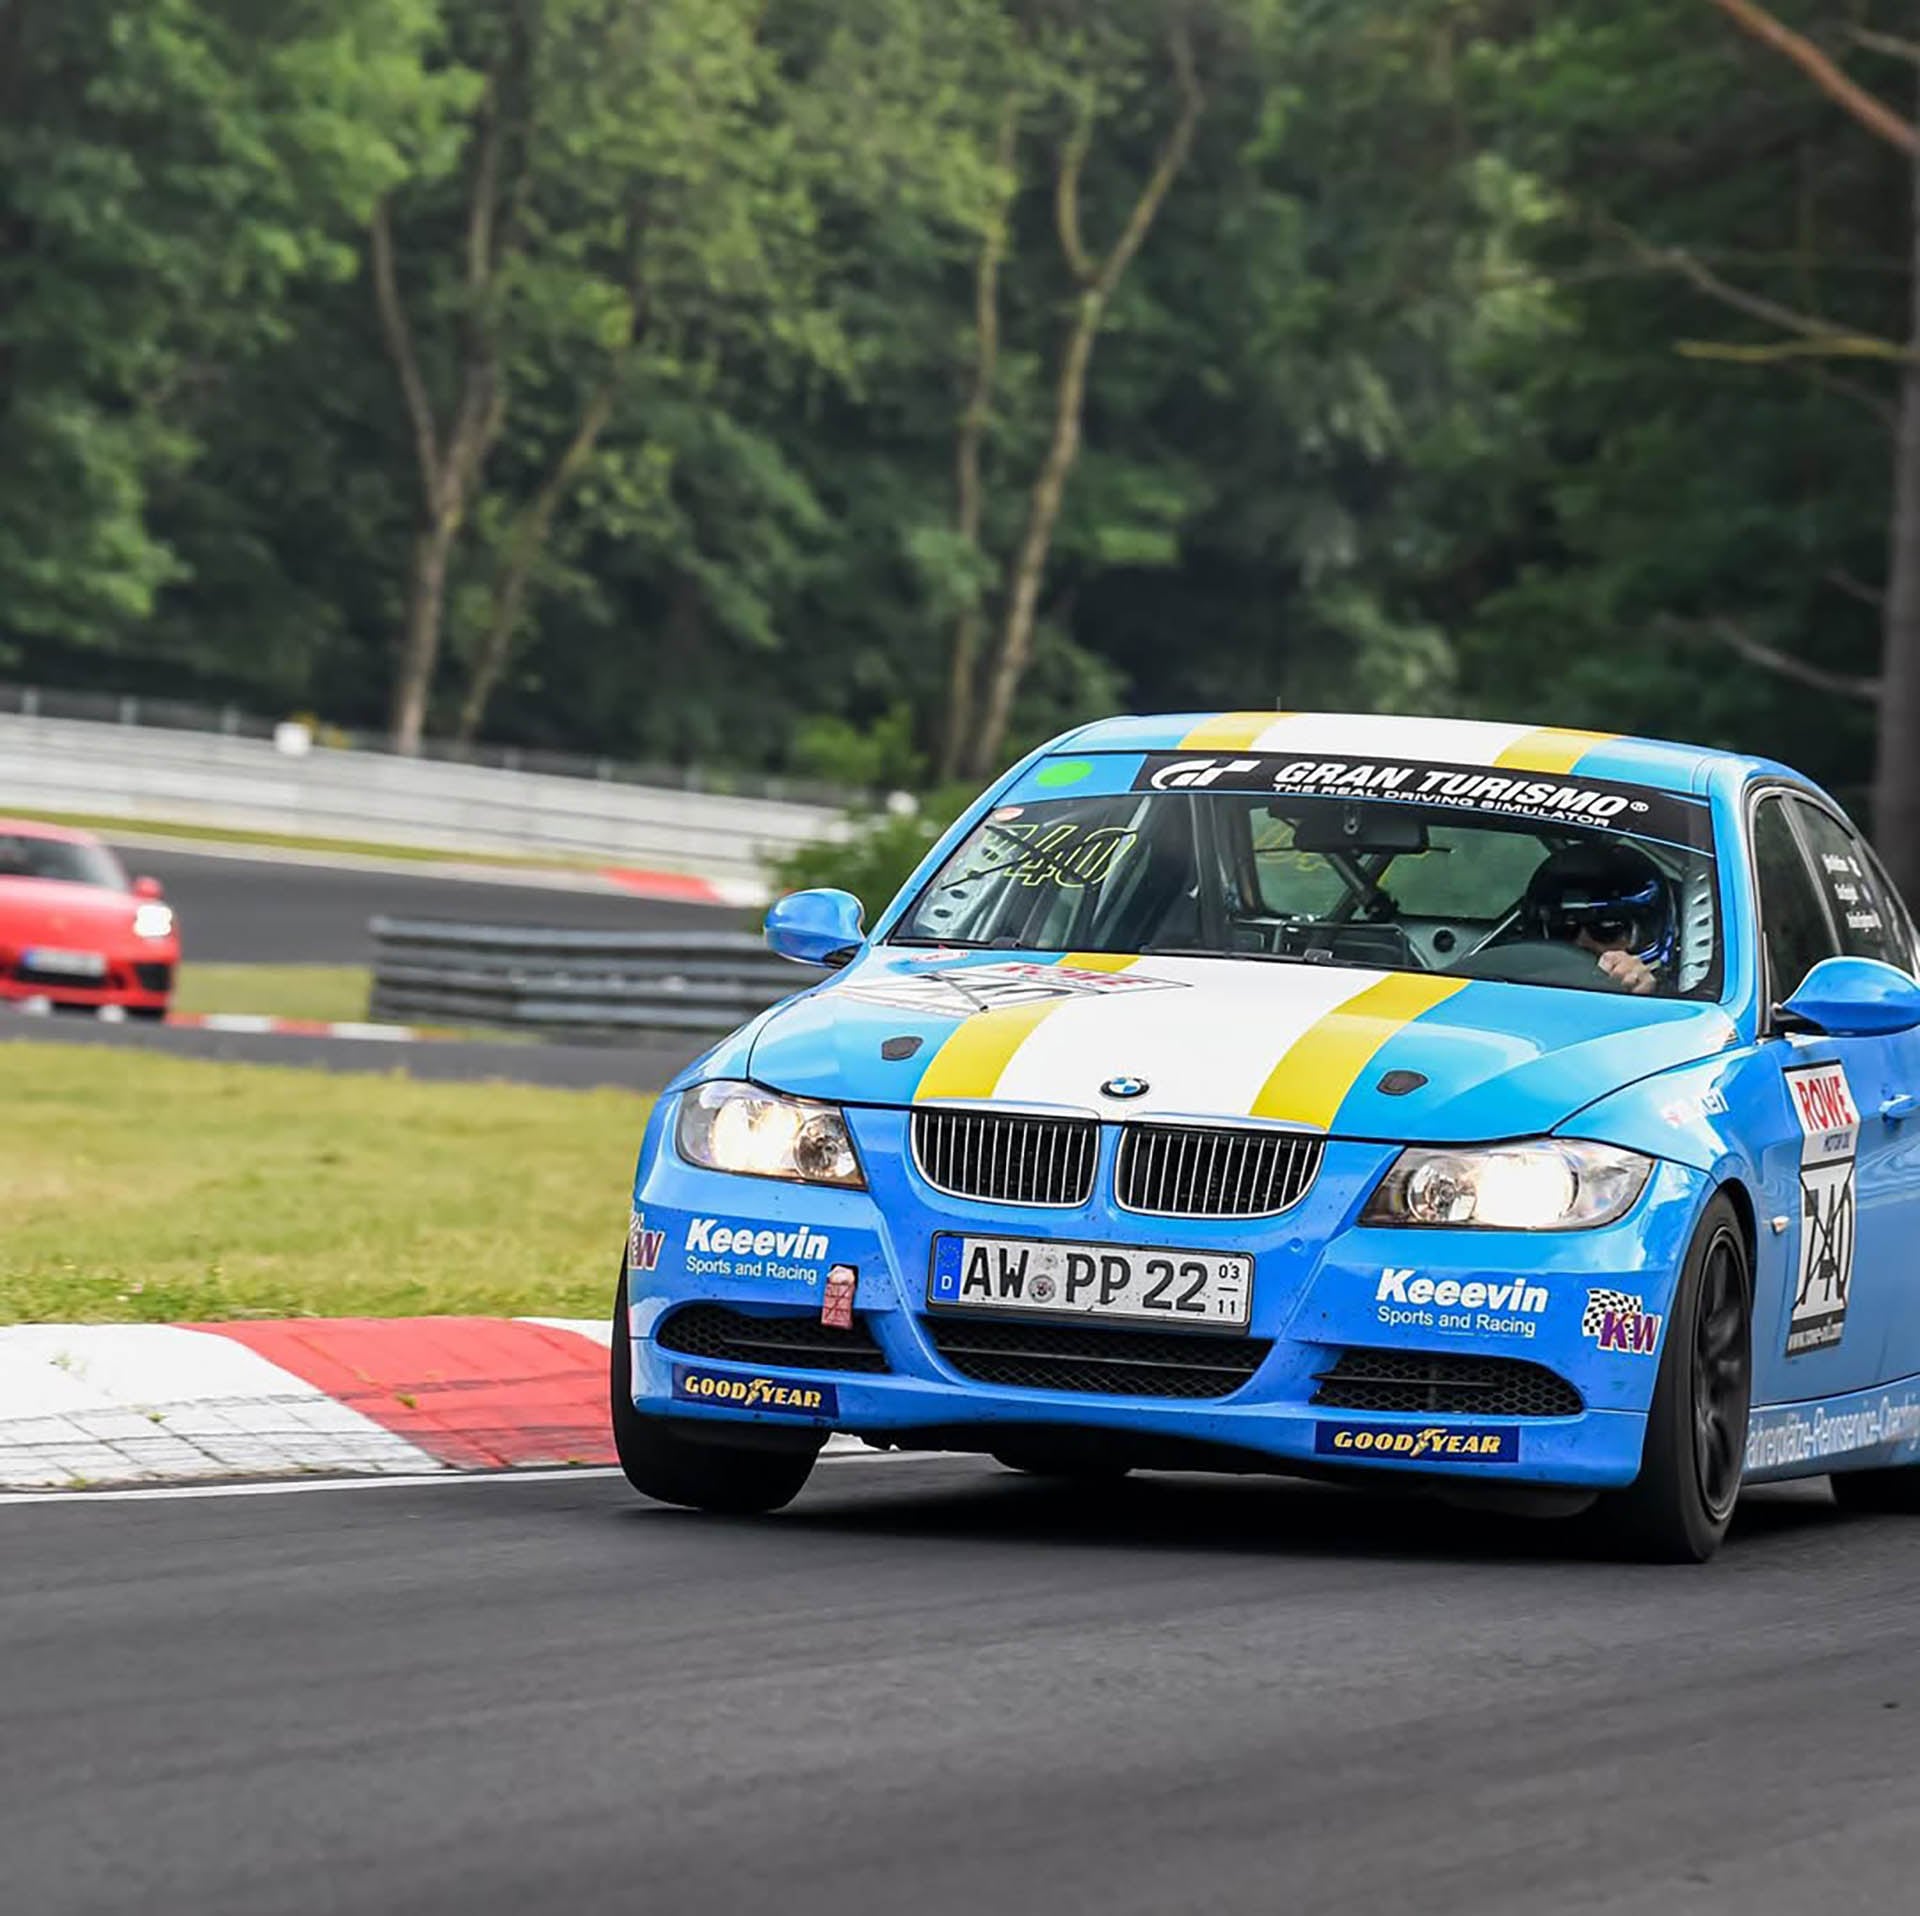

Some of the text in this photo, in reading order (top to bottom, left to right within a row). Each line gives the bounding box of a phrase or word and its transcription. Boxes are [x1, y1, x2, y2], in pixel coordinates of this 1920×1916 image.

[1274, 762, 1414, 789] GRAN
[1273, 783, 1610, 827] THE REAL DRIVING SIMULATOR
[1795, 1074, 1853, 1131] ROWE
[685, 1218, 829, 1261] Keeevin
[1801, 1183, 1852, 1304] 740
[686, 1256, 817, 1285] Sports and Racing
[941, 1246, 1208, 1312] D AW PP 22
[1218, 1263, 1240, 1279] 03
[1375, 1267, 1548, 1313] Keeevin
[1218, 1299, 1236, 1314] 11
[1377, 1307, 1536, 1338] Sports and Racing
[1598, 1311, 1661, 1355] KW
